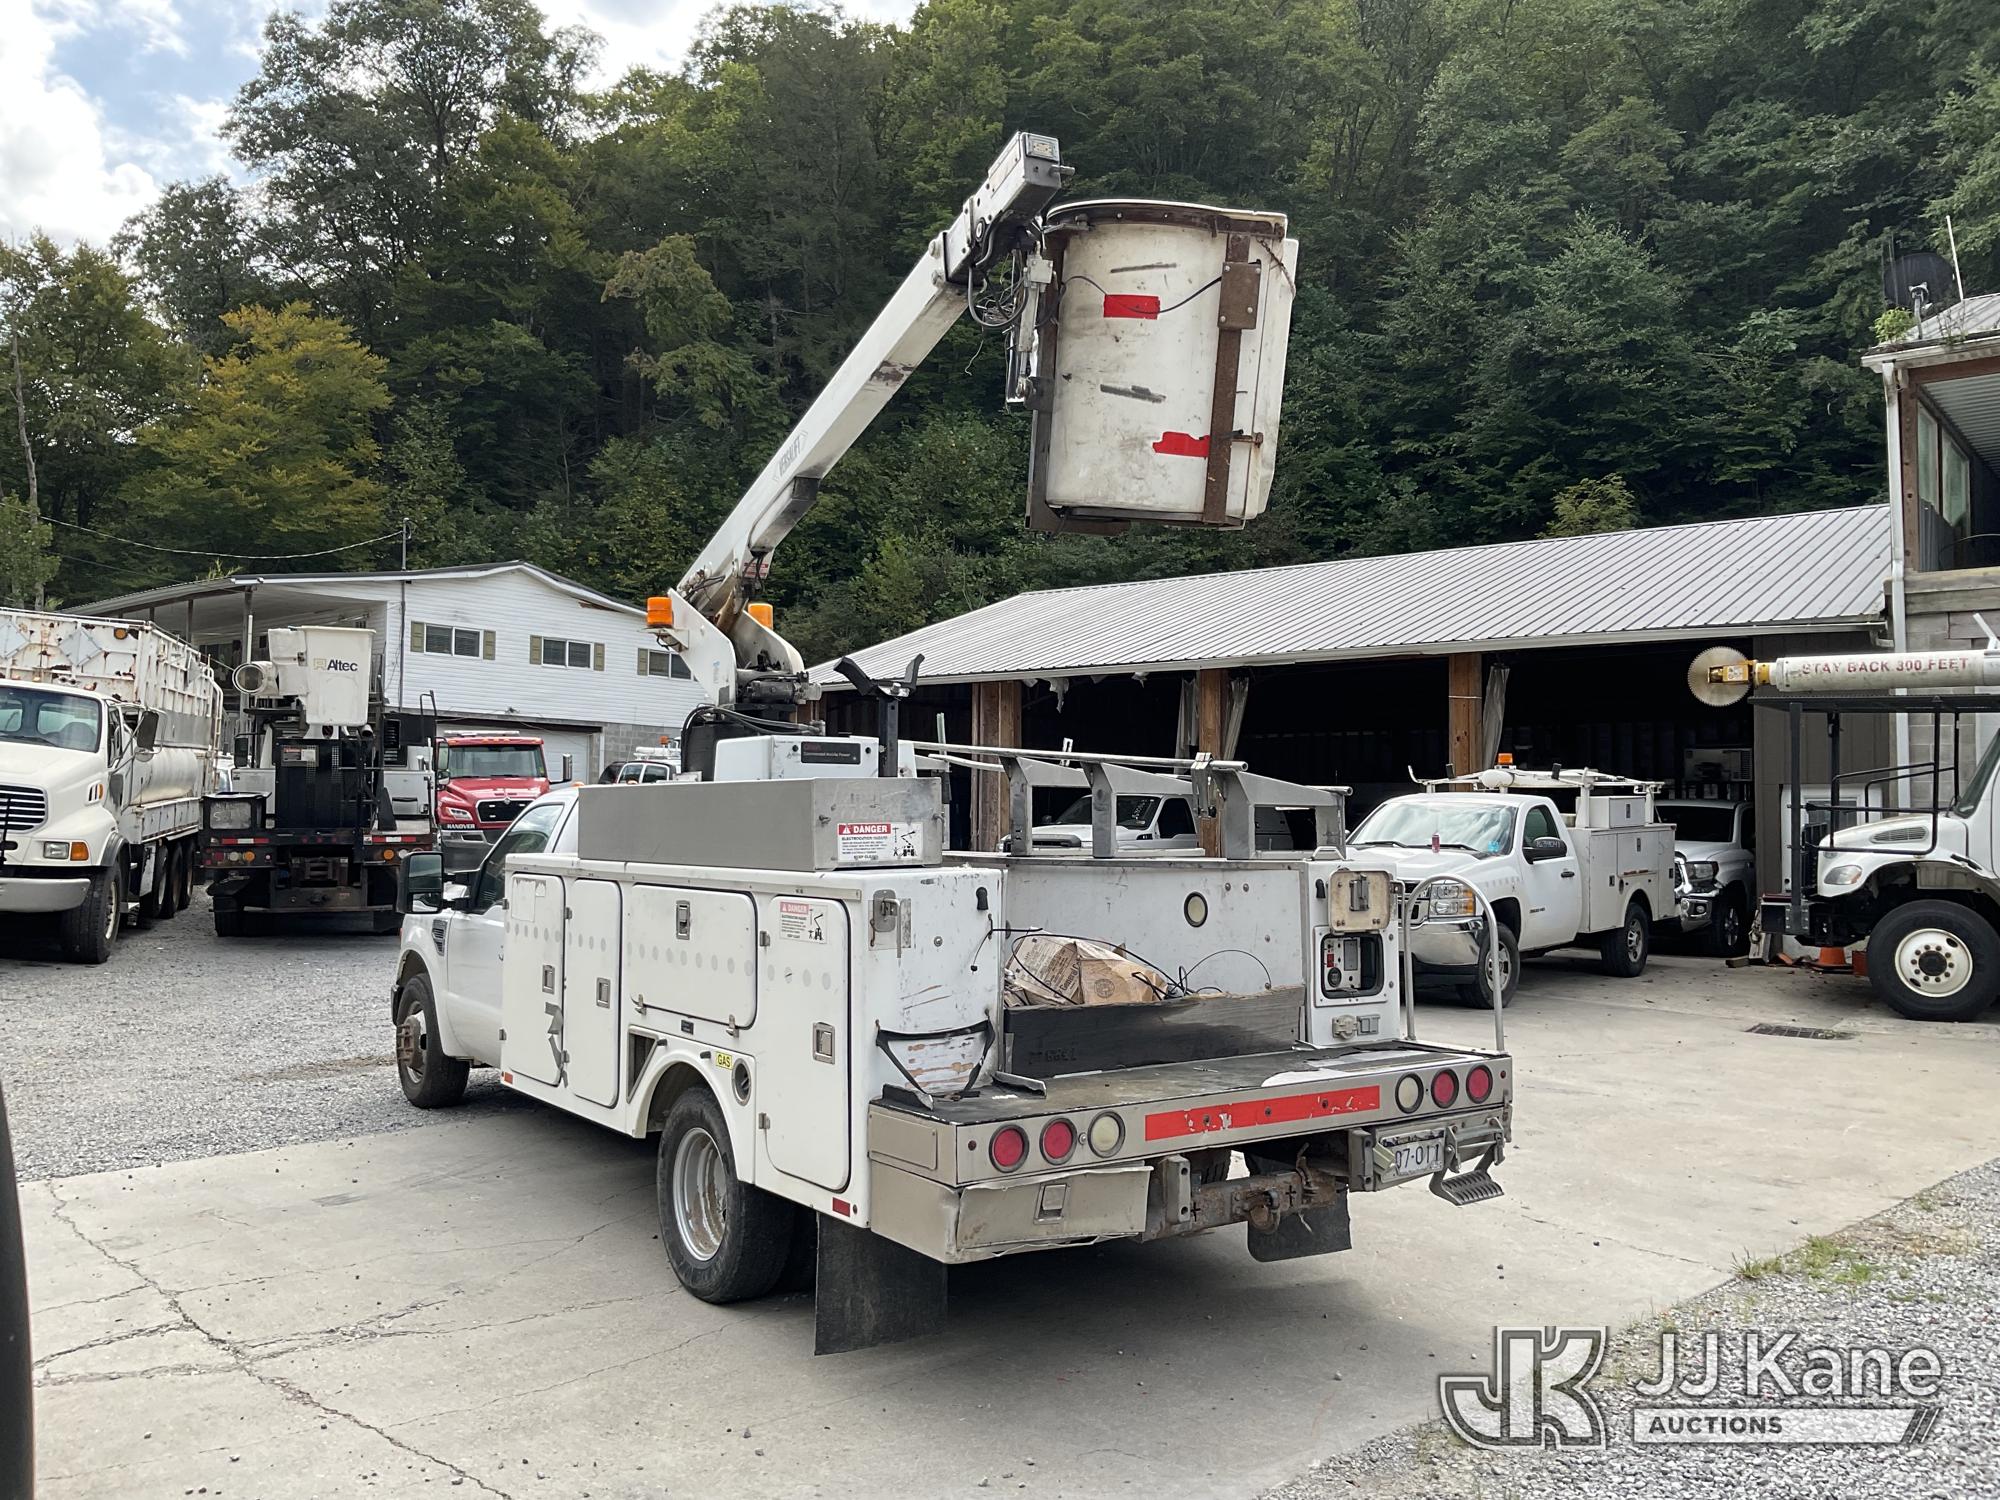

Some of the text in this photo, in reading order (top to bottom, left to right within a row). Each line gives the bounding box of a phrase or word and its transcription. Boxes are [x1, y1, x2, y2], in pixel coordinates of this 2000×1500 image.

[327, 659, 358, 672] Altec
[1802, 657, 1969, 675] STAY BACK 300 FEET
[853, 825, 888, 833] DANGER
[787, 903, 807, 914] DANGER
[718, 1054, 731, 1067] GAS
